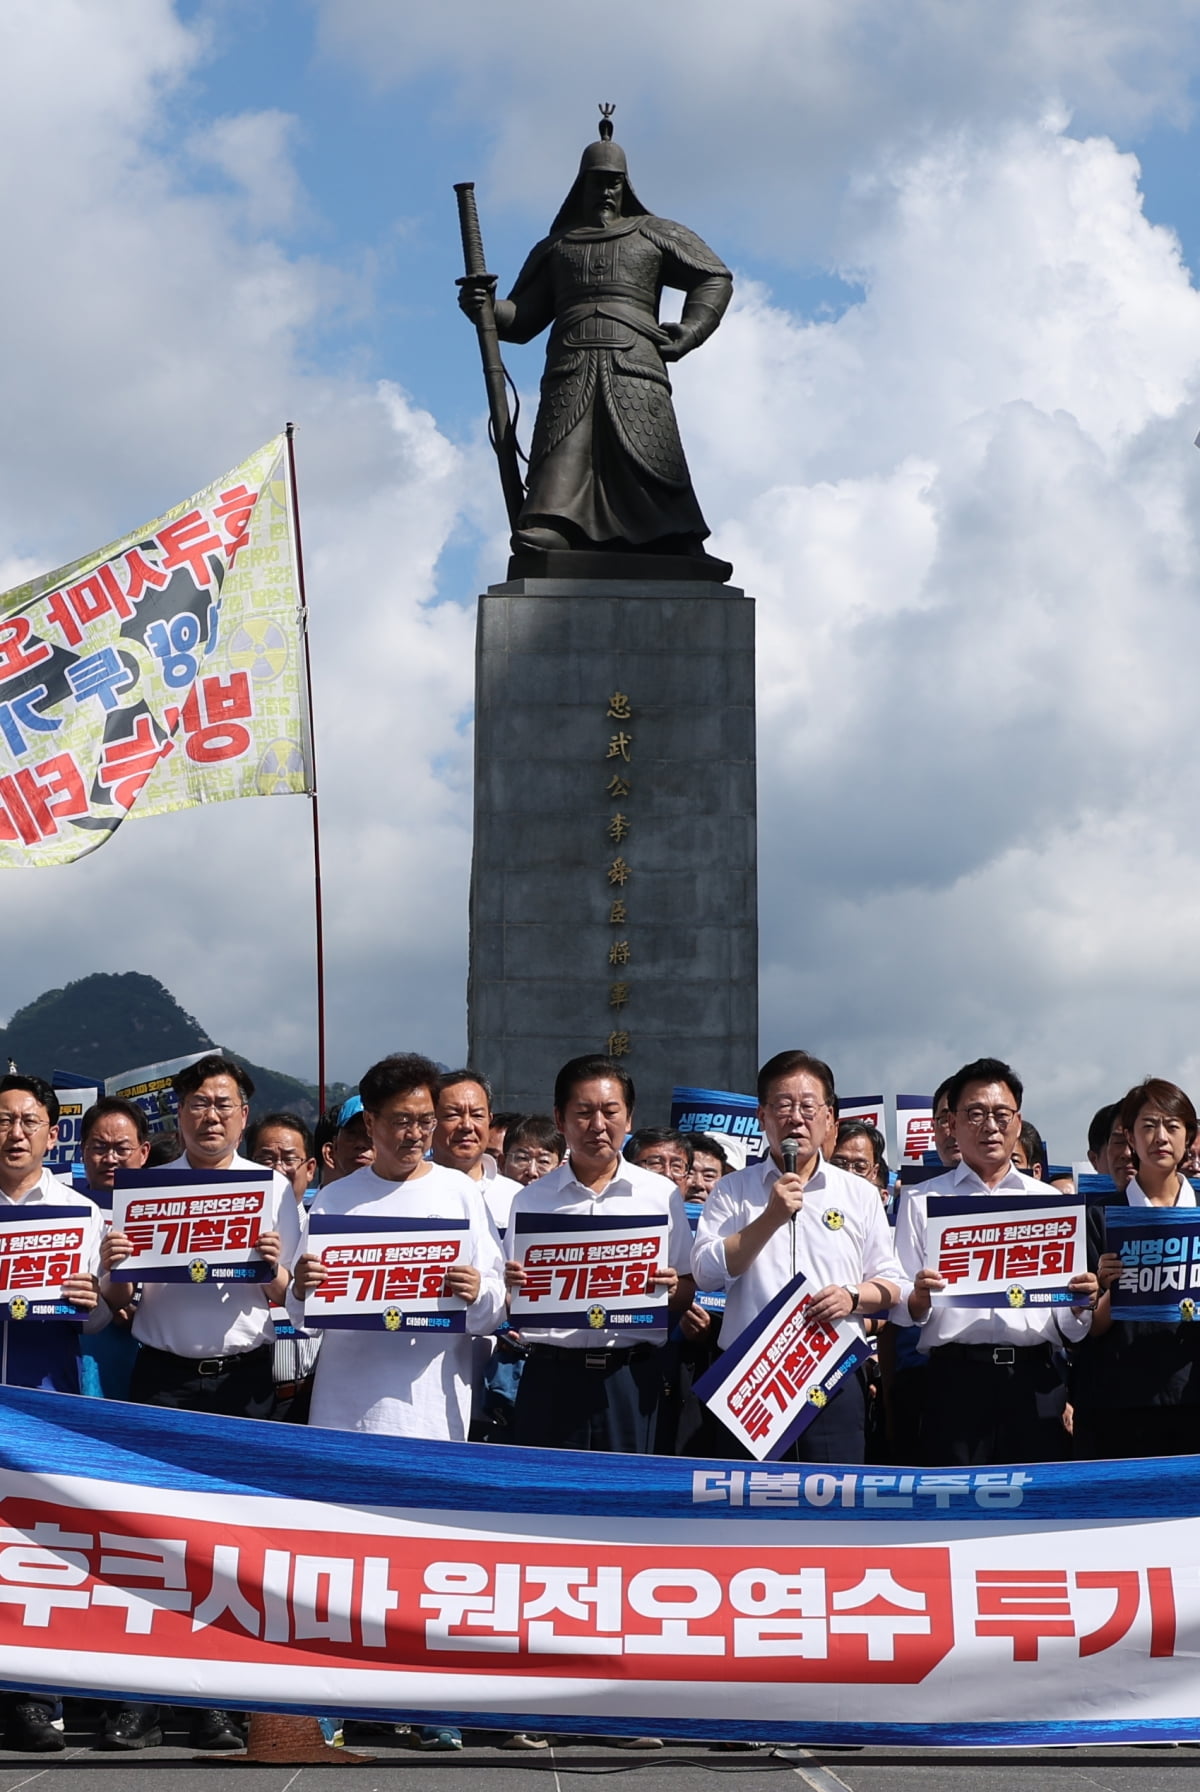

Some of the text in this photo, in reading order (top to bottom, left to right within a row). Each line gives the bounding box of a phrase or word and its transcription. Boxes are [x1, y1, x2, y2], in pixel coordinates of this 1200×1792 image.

[678, 1112, 733, 1133] 생명의
[129, 1196, 259, 1220] 후쿠시마 원전오염수
[10, 1232, 80, 1250] 원전오염수
[124, 1217, 260, 1256] 투기철회
[944, 1223, 1072, 1247] 후쿠시마 원전오염수
[324, 1243, 456, 1264] 후쿠시마 원전오염수
[528, 1242, 657, 1264] 후쿠시마 원전오염수
[938, 1241, 1074, 1284] 투기철회
[1119, 1237, 1189, 1266] 생명의
[211, 1267, 256, 1278] 더불어민주당
[314, 1266, 453, 1302] 투기철회
[519, 1263, 657, 1301] 투기철회
[1119, 1264, 1187, 1293] 죽이지
[32, 1304, 76, 1315] 더불어민주당
[406, 1316, 451, 1328] 더불어민주당
[609, 1313, 654, 1325] 더불어민주당
[729, 1356, 772, 1410] 후쿠시마
[741, 1319, 840, 1442] 투기철회
[692, 1470, 1033, 1509] 더불어민주당
[0, 1522, 1177, 1662] 후쿠시마 원전오염수 투기
